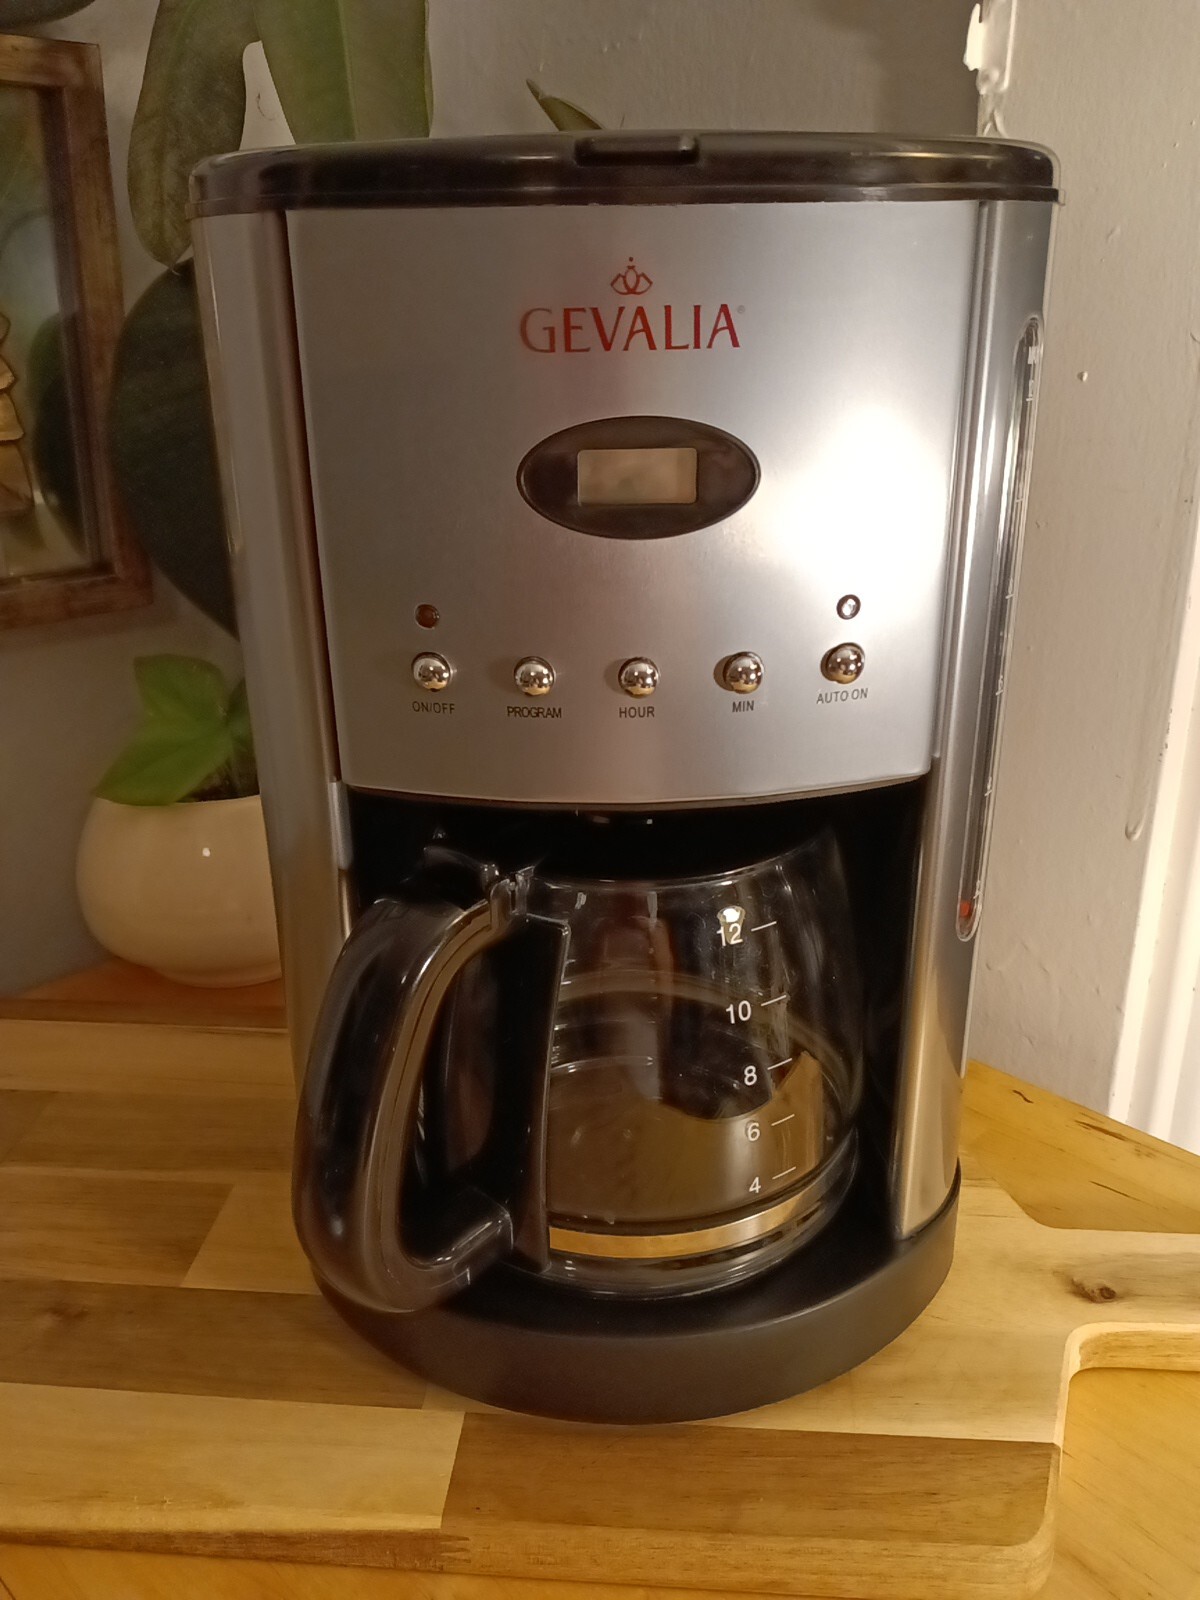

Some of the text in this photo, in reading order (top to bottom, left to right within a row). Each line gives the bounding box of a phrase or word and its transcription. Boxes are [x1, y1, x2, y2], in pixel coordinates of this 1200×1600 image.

[519, 303, 740, 353] GEVALIA
[816, 687, 869, 705] AUTO ON
[412, 701, 455, 715] ON/OFF
[507, 705, 562, 719] PROGRAM
[619, 706, 655, 719] HOUR
[732, 701, 755, 713] MIN
[716, 922, 743, 947] 12
[725, 1000, 752, 1025] 10
[743, 1065, 758, 1086] 8
[747, 1122, 761, 1142] 6
[749, 1176, 762, 1194] 4
